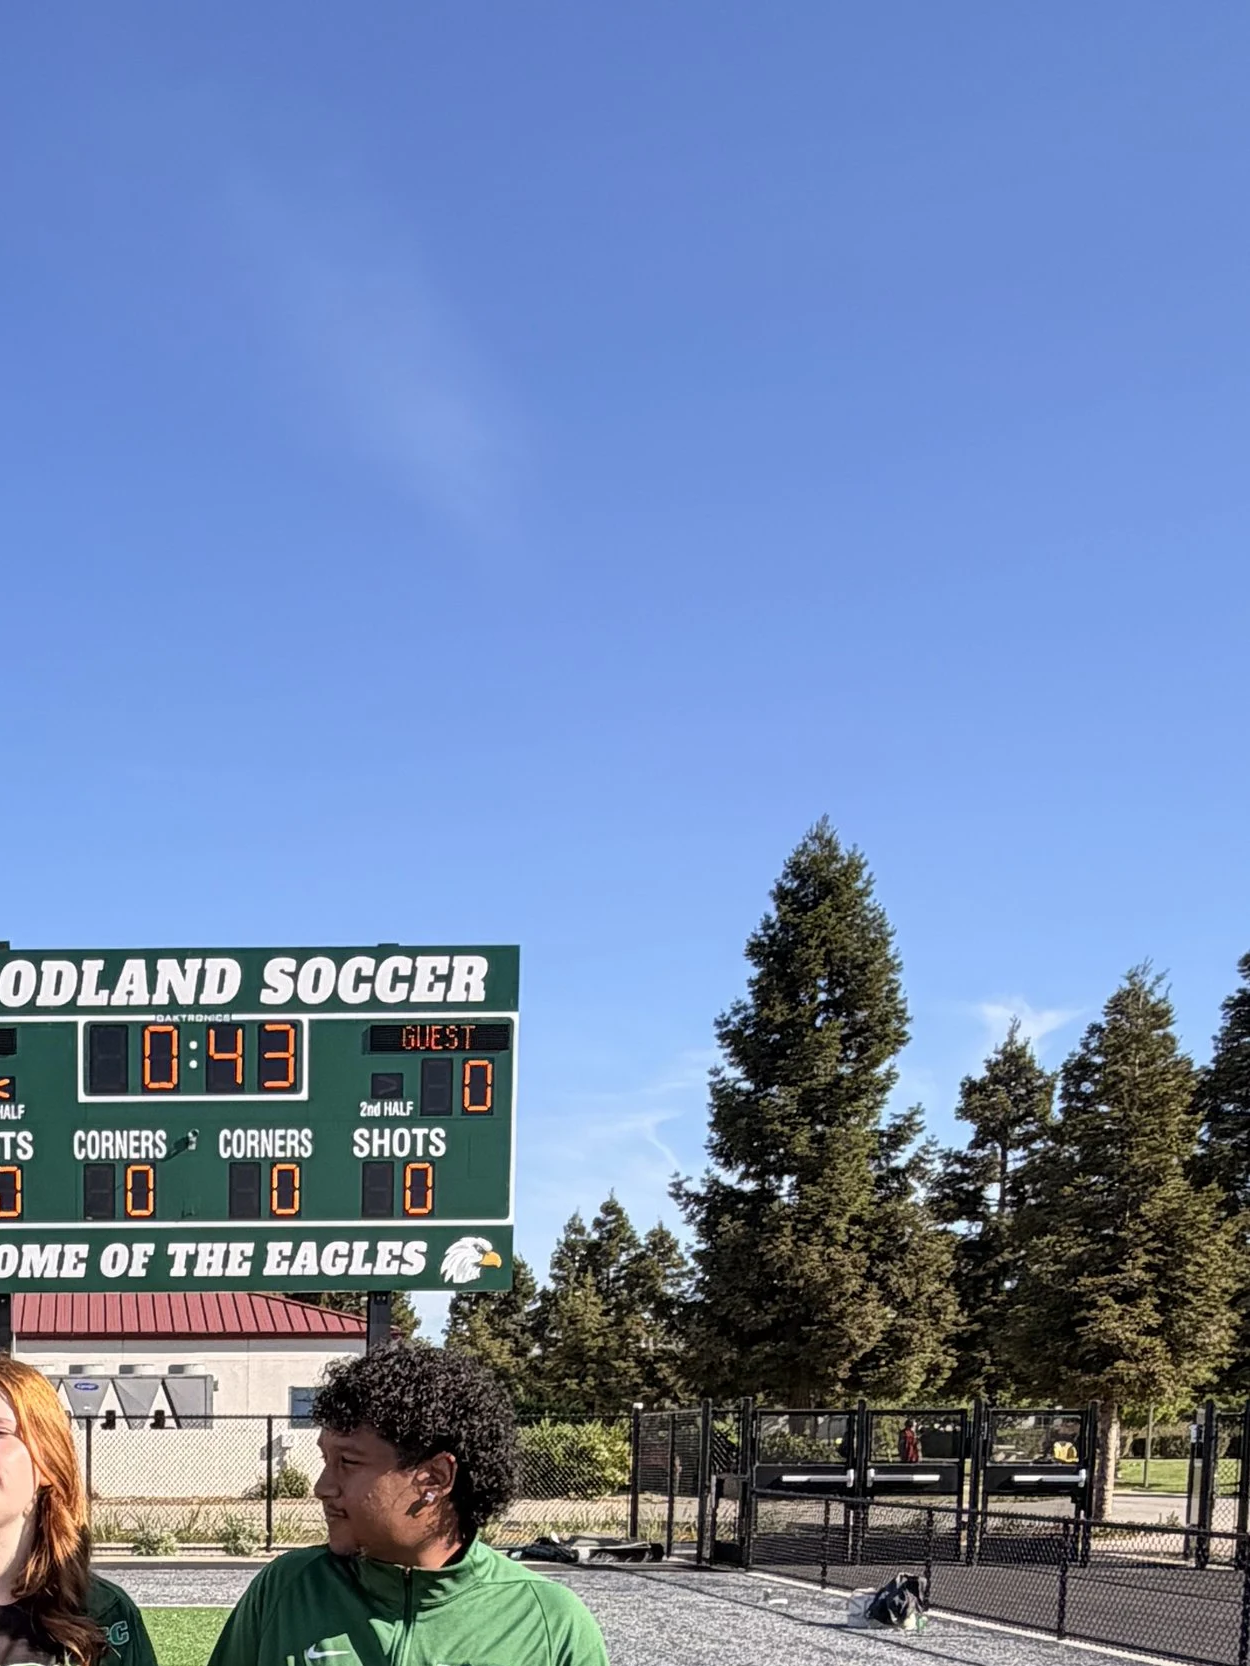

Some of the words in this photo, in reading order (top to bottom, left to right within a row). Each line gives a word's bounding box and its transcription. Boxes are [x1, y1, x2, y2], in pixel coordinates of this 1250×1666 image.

[259, 955, 490, 1005] SOCCER
[143, 1023, 296, 1090] 0:43
[401, 1025, 477, 1050] GUEST
[463, 1059, 493, 1112] 0
[359, 1101, 381, 1117] 2nd
[383, 1100, 414, 1117] HALF
[73, 1129, 167, 1160] CORNERS
[218, 1127, 313, 1159] CORNERS
[352, 1126, 447, 1158] SHOTS
[126, 1165, 155, 1217] 0
[271, 1163, 300, 1215] 0
[404, 1162, 433, 1215] 0
[100, 1242, 156, 1278] OF
[166, 1241, 256, 1278] THE
[262, 1239, 428, 1277] EAGLES
